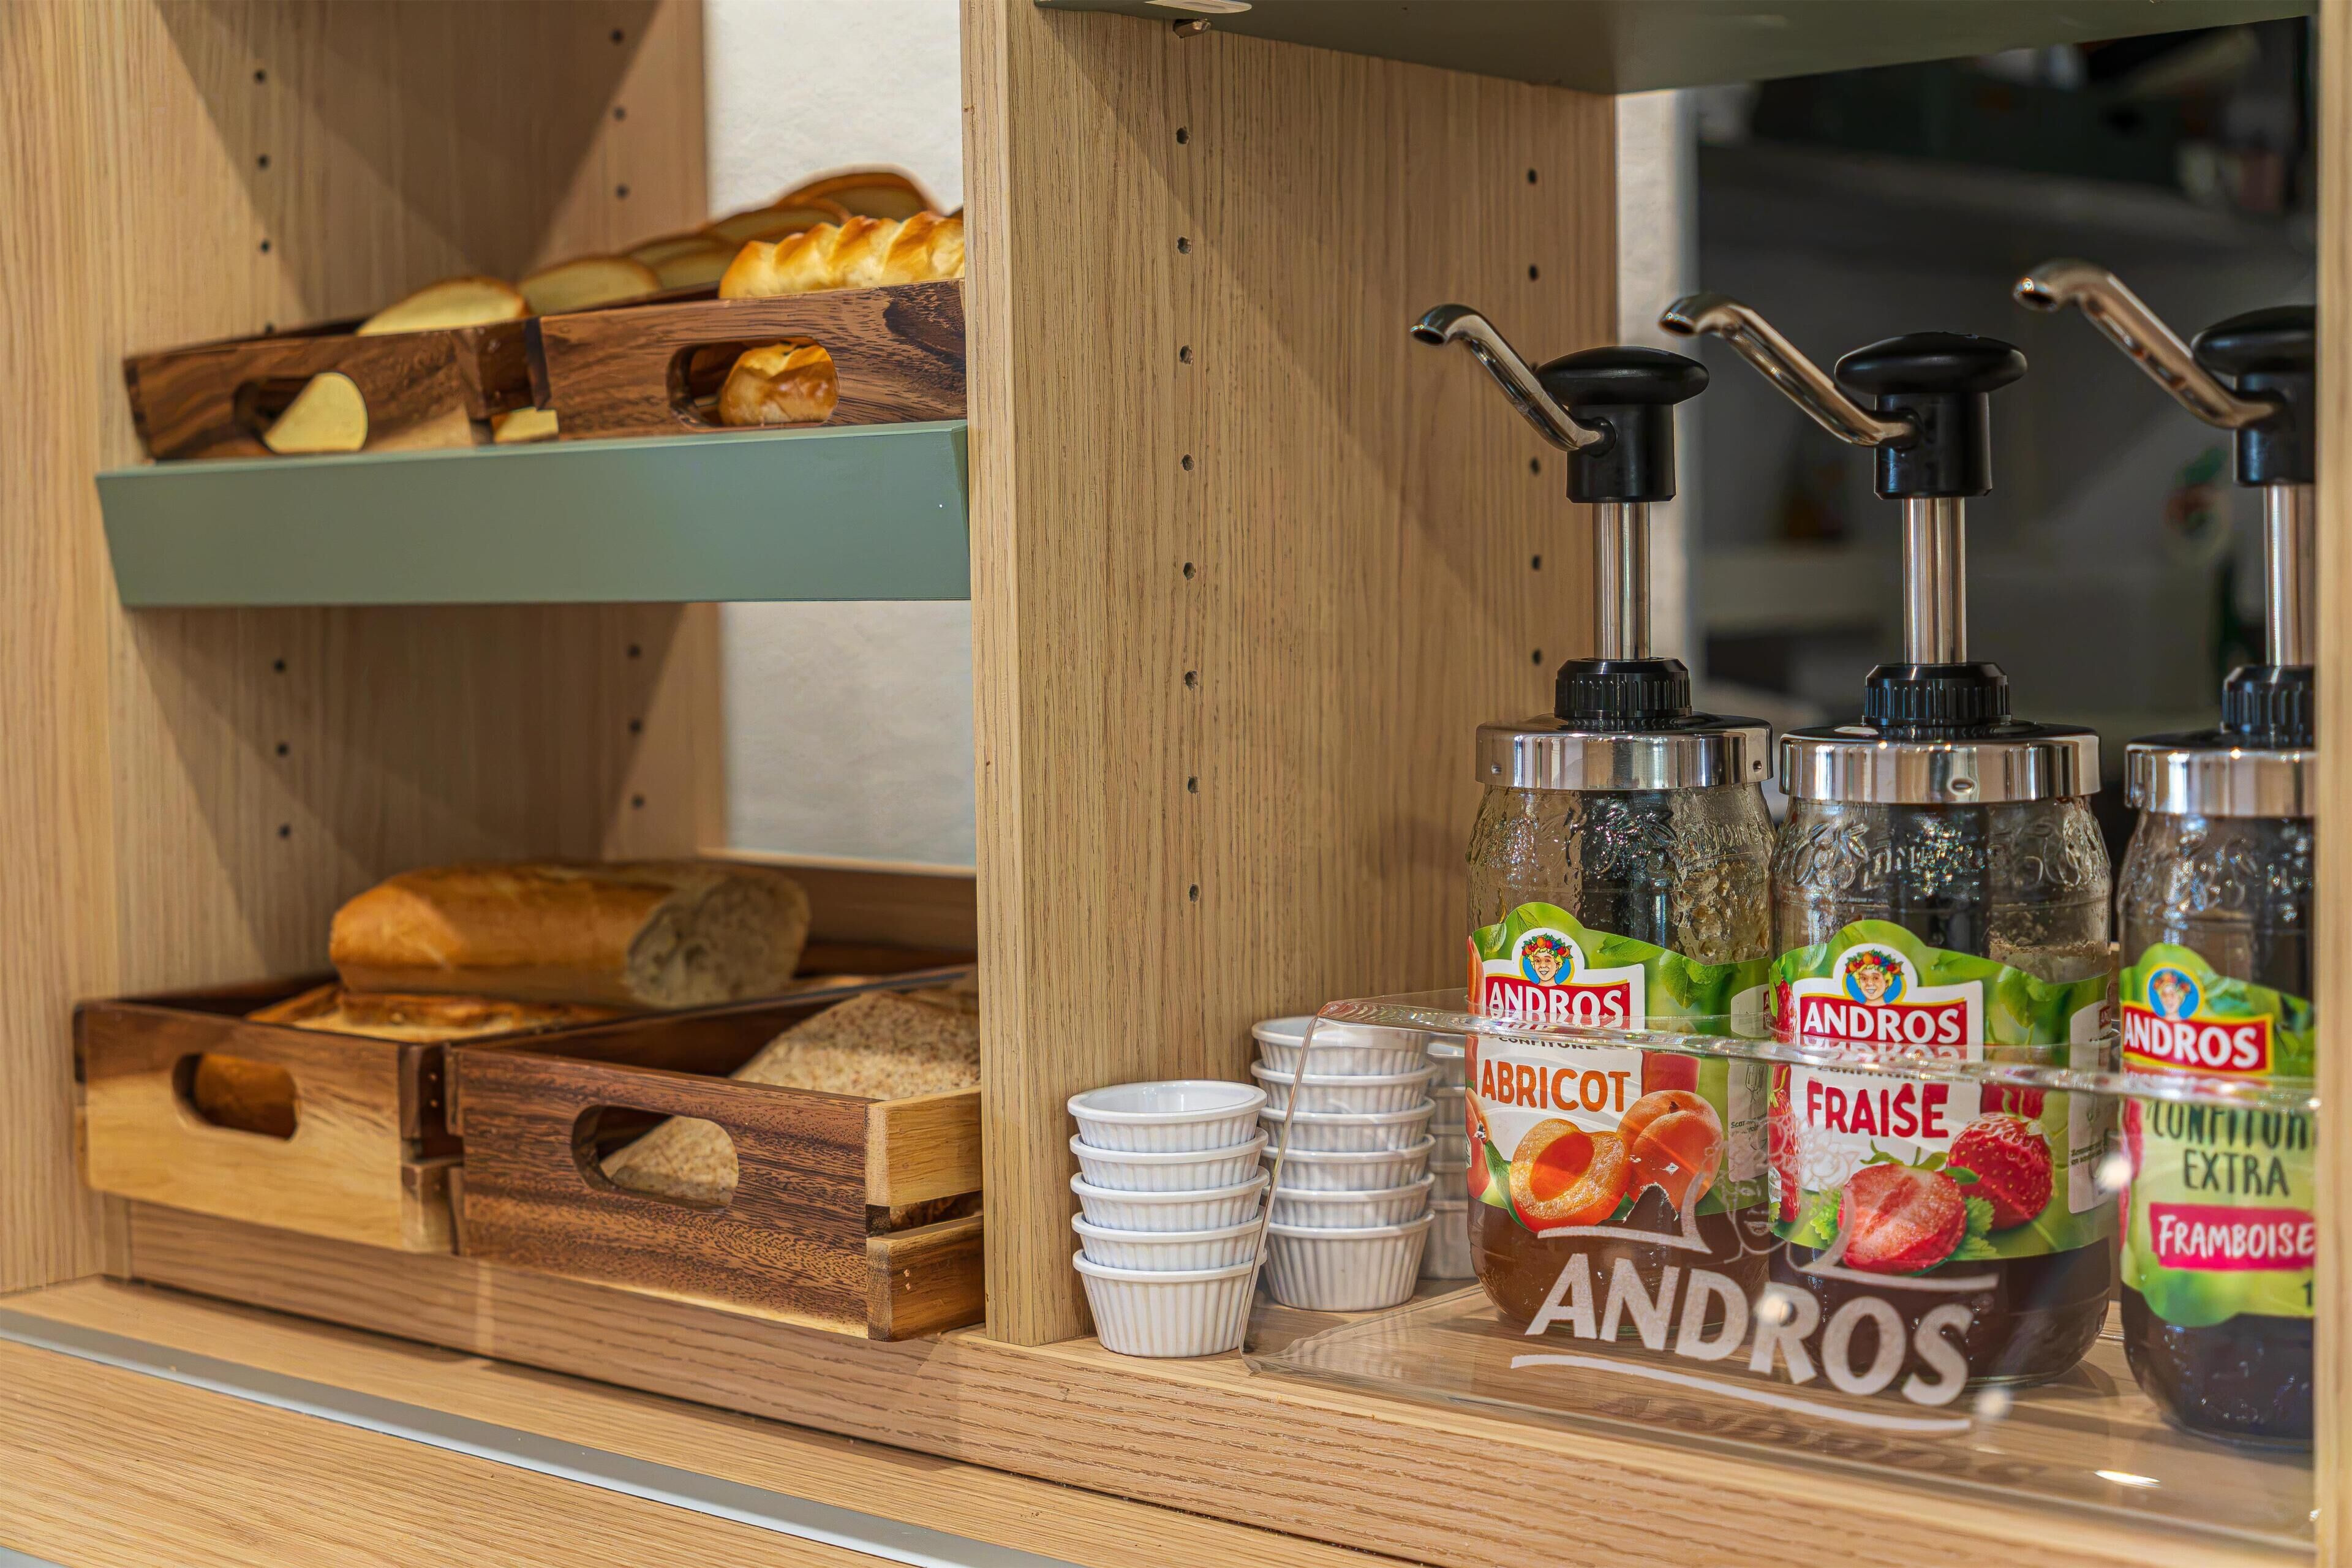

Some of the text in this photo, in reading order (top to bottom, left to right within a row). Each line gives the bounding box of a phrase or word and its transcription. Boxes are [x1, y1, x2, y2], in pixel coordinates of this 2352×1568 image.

[1489, 981, 1623, 1020] ANDROS
[1803, 1001, 1961, 1044] ANDROS
[2124, 1011, 2260, 1069] ANDROS
[1480, 1059, 1631, 1113] ABRICOT
[1806, 1076, 1949, 1139] FRAISE
[2152, 1101, 2317, 1150] CONFITUR
[2184, 1149, 2290, 1197] EXTRA
[2158, 1215, 2315, 1259] FRAMBOISE
[1524, 1252, 1974, 1407] ANDROS
